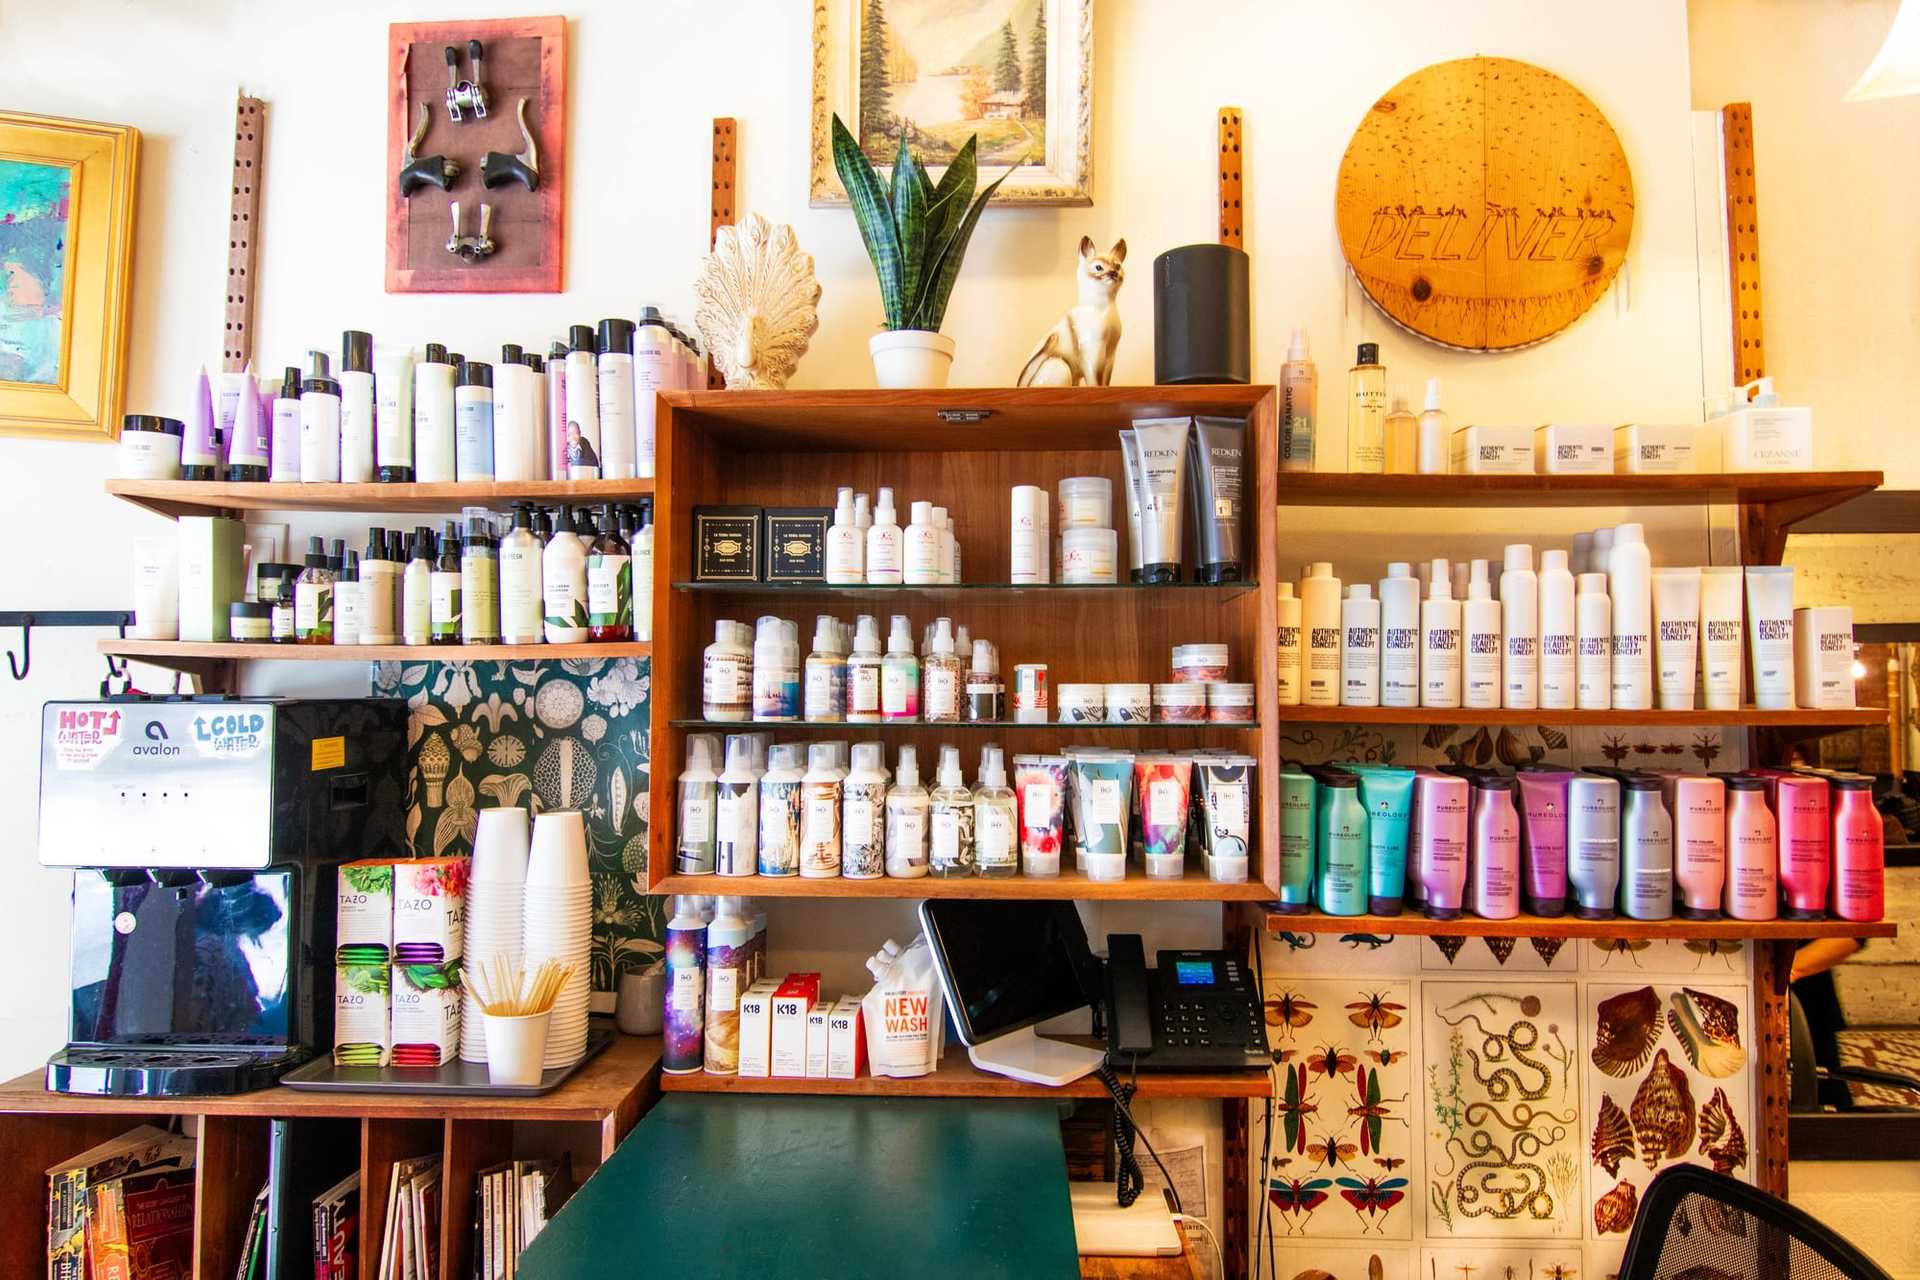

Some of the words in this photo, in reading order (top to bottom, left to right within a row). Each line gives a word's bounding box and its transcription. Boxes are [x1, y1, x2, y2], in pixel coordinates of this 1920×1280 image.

[1360, 207, 1616, 262] DELIVER
[1285, 386, 1293, 426] FANATIC
[1144, 449, 1178, 458] REDKEN
[1211, 447, 1242, 457] REDKEN
[1278, 640, 1297, 648] NCEPT
[1387, 641, 1414, 649] CONCEPT
[59, 711, 107, 729] HOT
[211, 714, 264, 735] COLD
[133, 743, 180, 755] avalon
[340, 895, 367, 904] TAZO
[398, 899, 432, 910] TAZO
[337, 995, 364, 1004] TAZO
[395, 994, 420, 1004] TAZO
[743, 1004, 760, 1014] K18
[777, 1004, 797, 1015] K18
[885, 997, 928, 1016] NEW
[831, 1020, 848, 1029] K18
[885, 1017, 928, 1032] WASH
